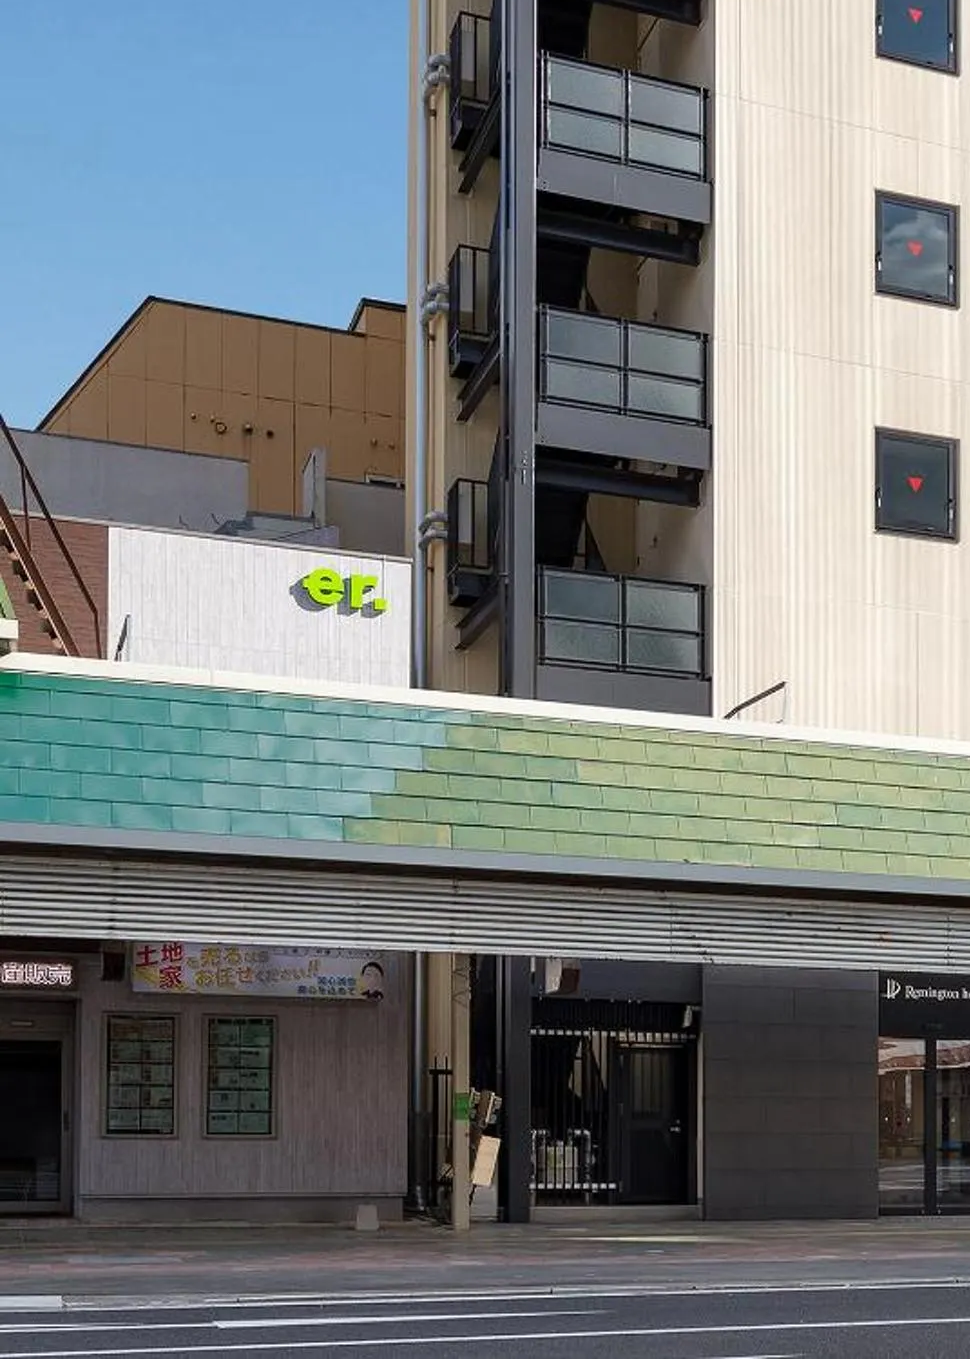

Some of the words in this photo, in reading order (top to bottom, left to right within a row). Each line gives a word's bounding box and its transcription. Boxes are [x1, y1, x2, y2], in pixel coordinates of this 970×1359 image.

[302, 566, 387, 610] er.
[136, 941, 184, 967] 土地
[905, 985, 960, 1001] Remington
